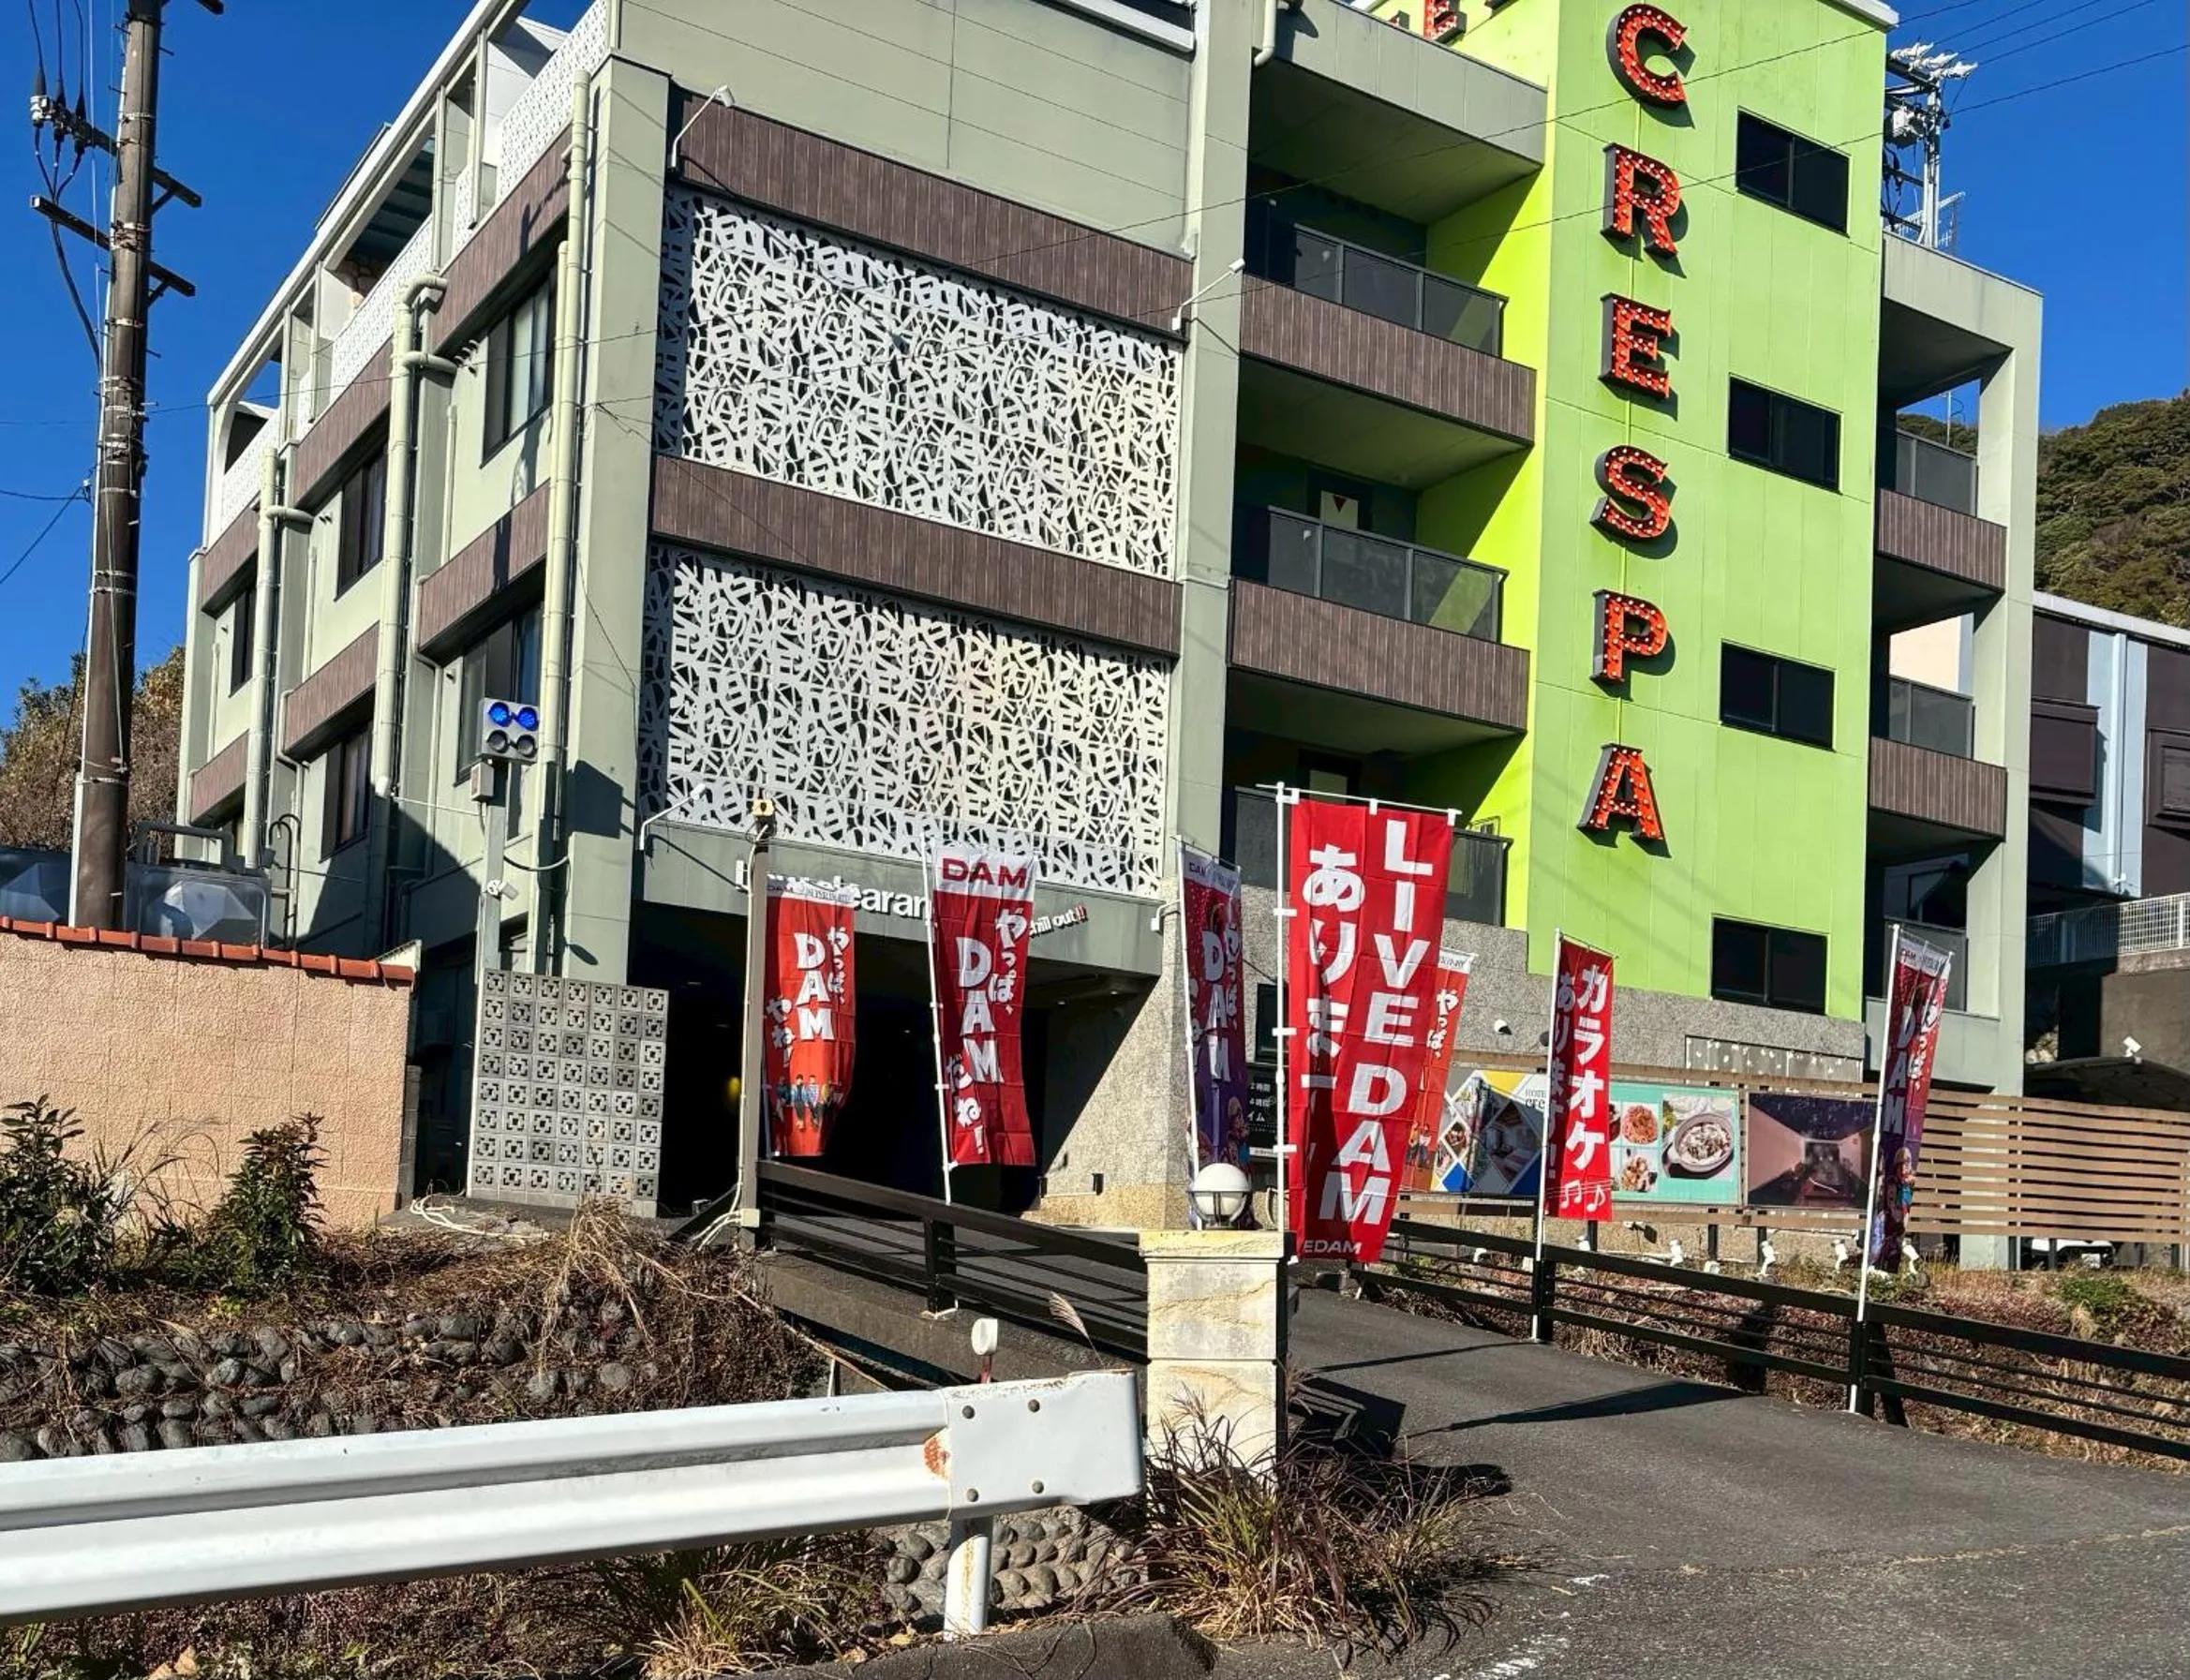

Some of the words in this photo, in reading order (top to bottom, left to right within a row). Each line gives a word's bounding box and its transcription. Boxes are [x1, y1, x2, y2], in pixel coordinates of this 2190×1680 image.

[1578, 3, 1689, 841] CRESPA
[943, 856, 1027, 889] DAM
[794, 931, 836, 1043] DAM
[956, 936, 1005, 1084] DAM
[1201, 930, 1232, 1082] DAM
[1566, 963, 1608, 1171] カラオケ
[1883, 1004, 1916, 1134] DAM
